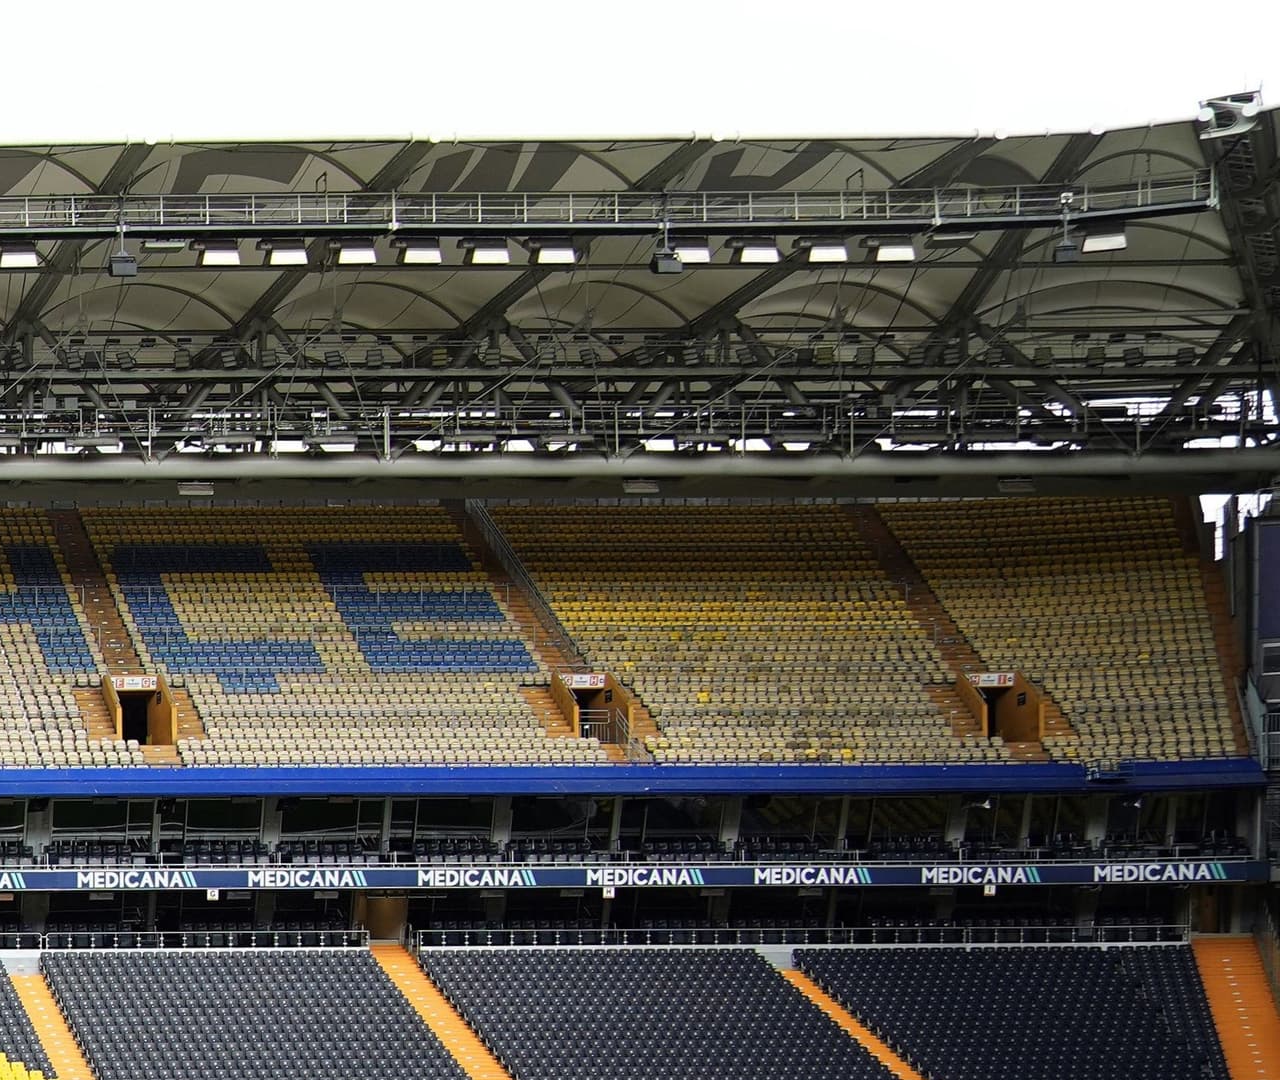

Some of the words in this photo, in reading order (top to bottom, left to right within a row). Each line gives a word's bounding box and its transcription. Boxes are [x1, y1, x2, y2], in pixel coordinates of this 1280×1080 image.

[77, 871, 183, 888] MEDICANA
[248, 870, 354, 887] MEDICANA
[417, 869, 523, 886] MEDICANA
[586, 868, 692, 886] MEDICANA
[754, 867, 859, 885] MEDICANA
[921, 866, 1026, 884] MEDICANA
[1094, 864, 1211, 882] MEDICANA
